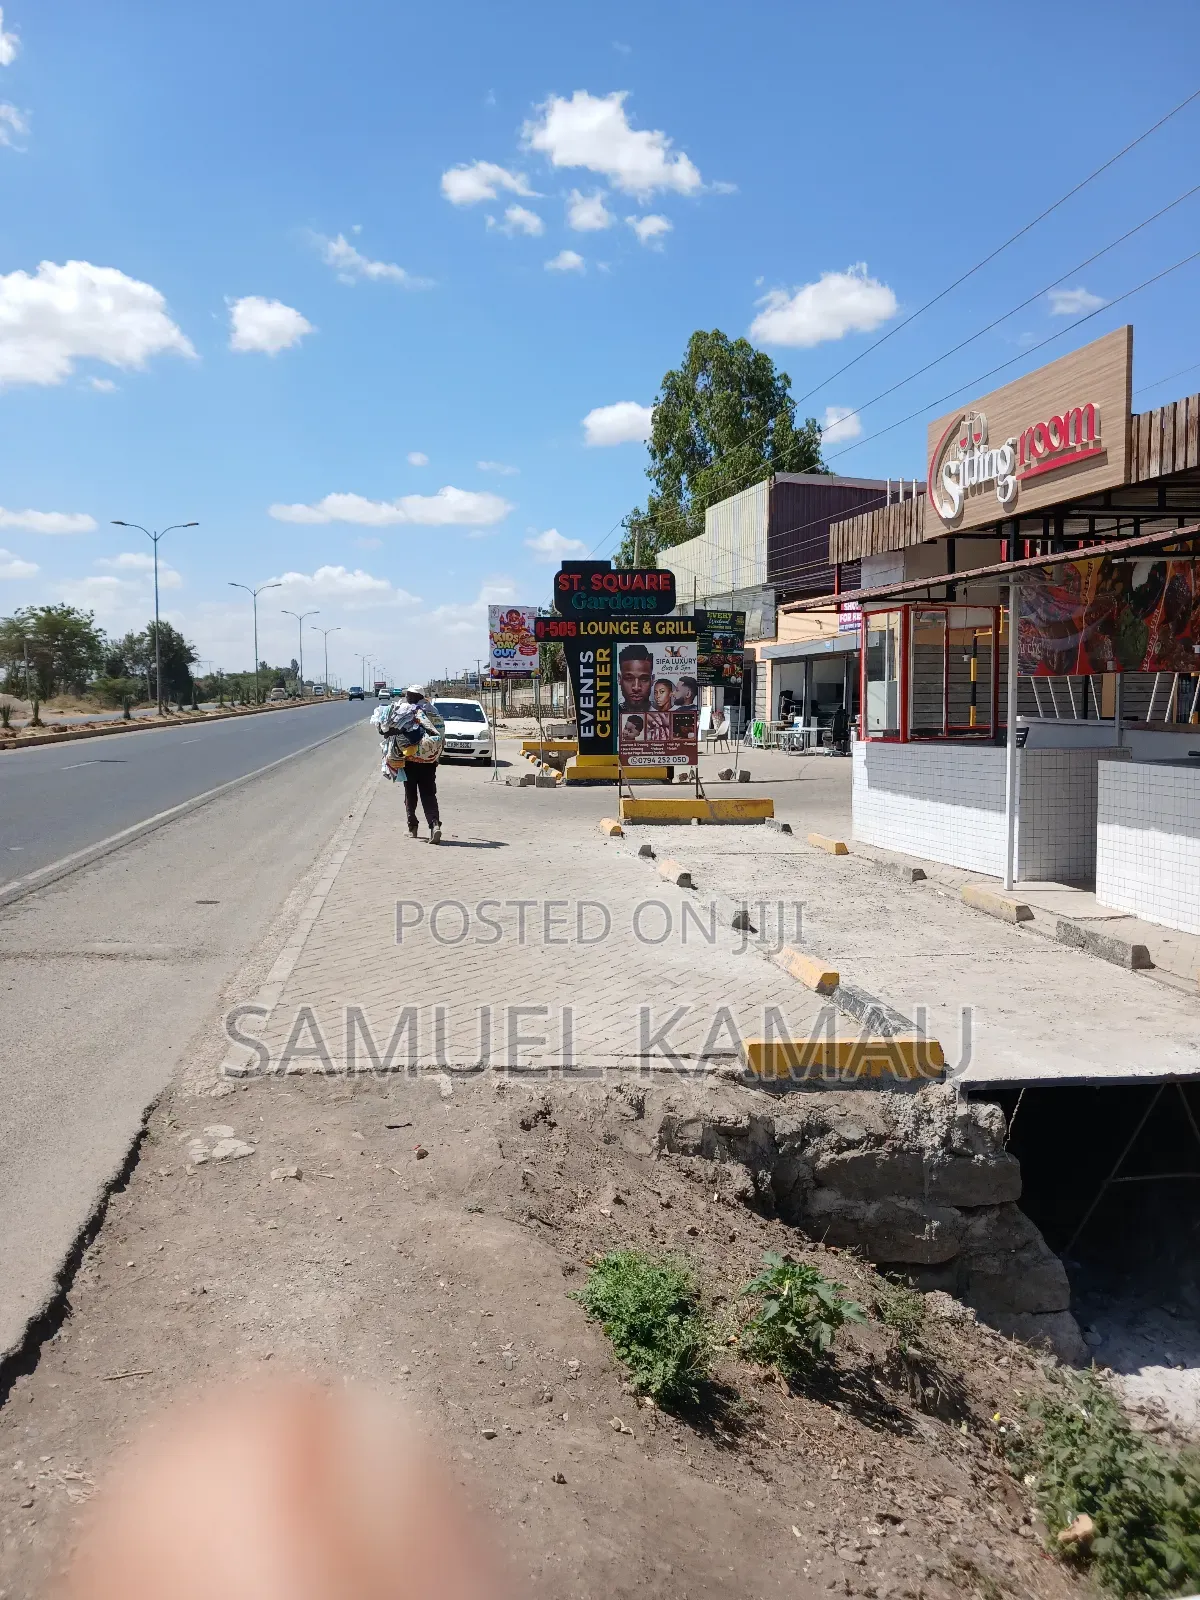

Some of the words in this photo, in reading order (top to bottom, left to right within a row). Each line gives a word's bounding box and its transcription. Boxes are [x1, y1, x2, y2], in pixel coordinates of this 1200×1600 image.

[942, 437, 1017, 519] Sitting
[1018, 402, 1101, 466] room
[558, 574, 586, 591] ST.
[591, 573, 671, 592] SQUARE
[571, 592, 657, 610] Gardens
[579, 621, 639, 635] LOUNGE
[642, 621, 652, 635] &
[655, 620, 696, 635] GRILL
[493, 632, 519, 643] KIDS
[496, 641, 516, 649] DAY
[493, 648, 517, 658] OUT
[671, 657, 697, 665] LUXURY
[580, 650, 595, 738] EVENTS
[596, 647, 611, 738] CENTER
